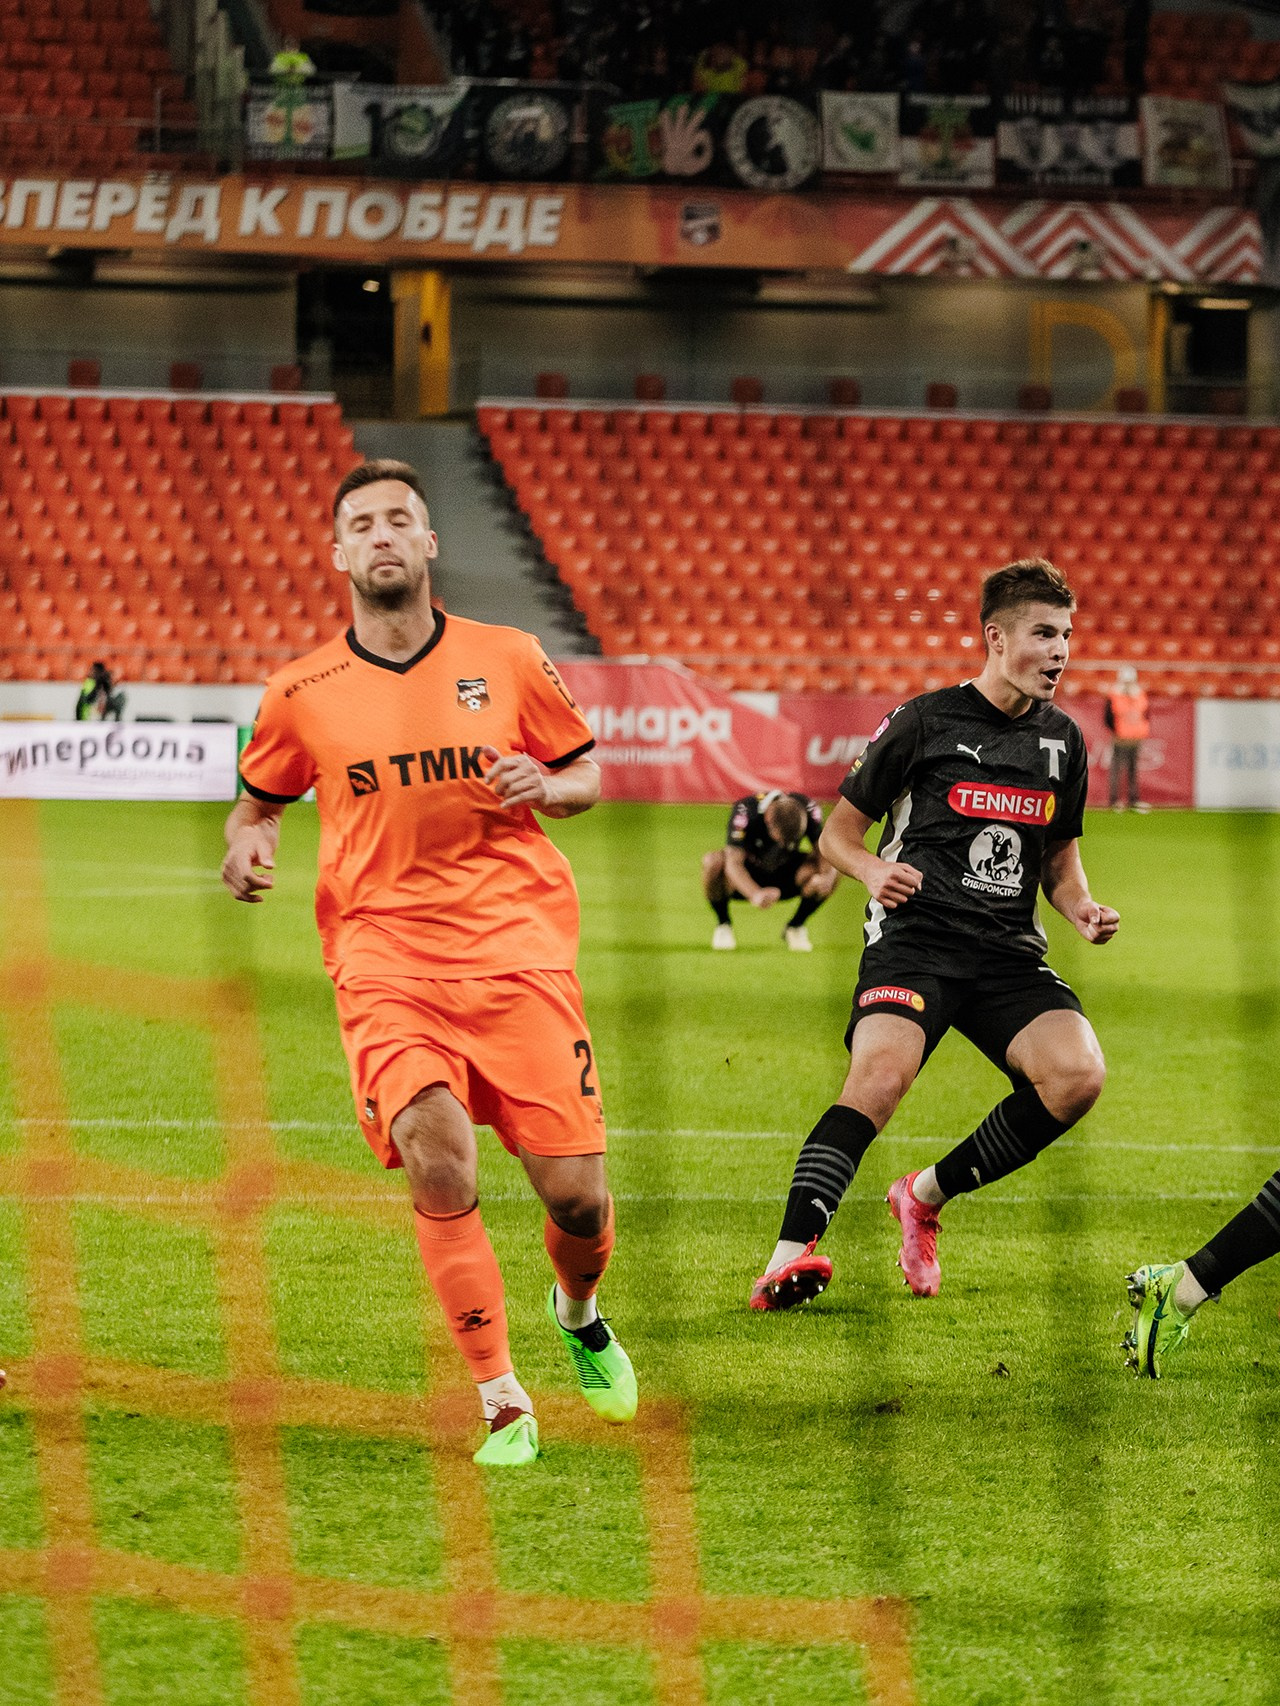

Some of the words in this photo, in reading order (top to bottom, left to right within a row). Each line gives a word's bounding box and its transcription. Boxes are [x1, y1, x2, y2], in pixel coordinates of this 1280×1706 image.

[0, 171, 222, 245] ПЕРЁД
[239, 185, 288, 237] К
[297, 189, 565, 254] ПОБЕДЕ
[0, 727, 206, 777] ипербола
[957, 788, 1042, 817] TENNISI
[862, 991, 910, 1004] TENNISI
[573, 1039, 596, 1097] 2
